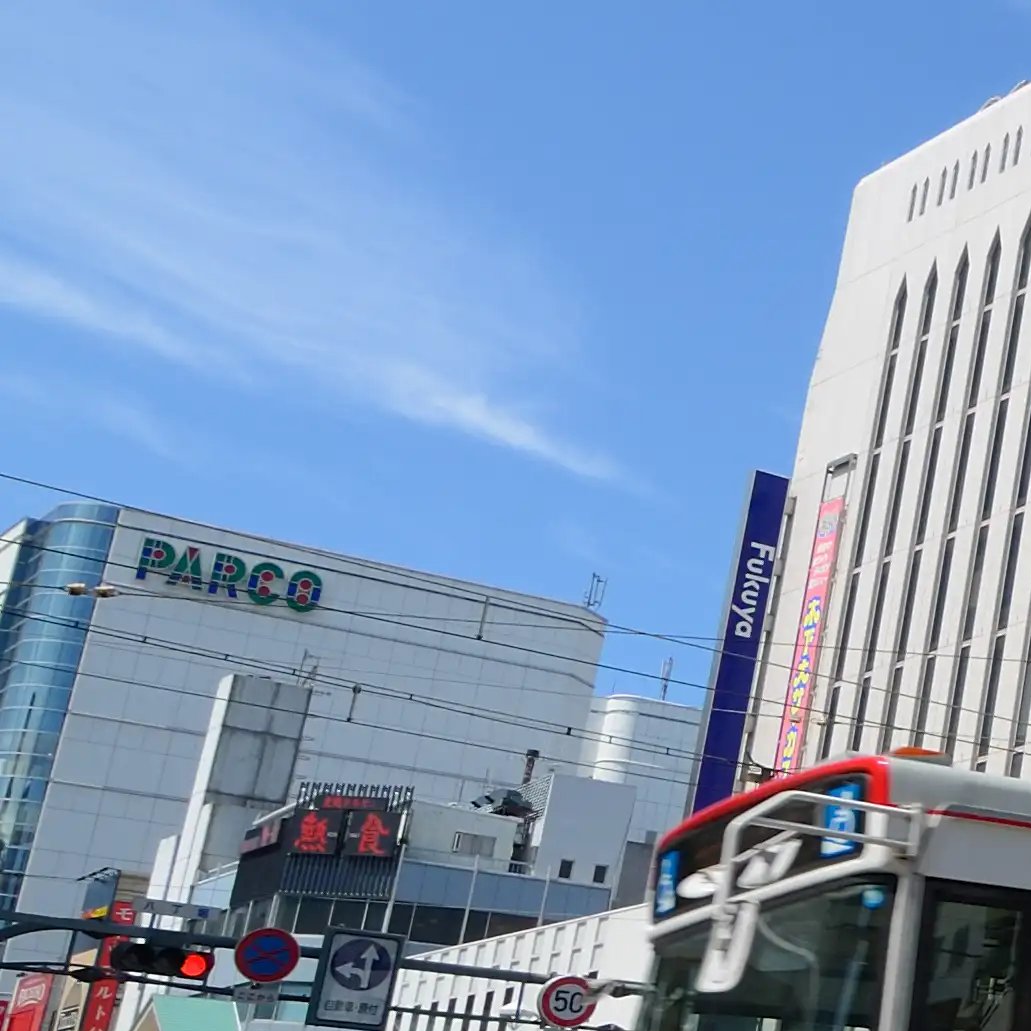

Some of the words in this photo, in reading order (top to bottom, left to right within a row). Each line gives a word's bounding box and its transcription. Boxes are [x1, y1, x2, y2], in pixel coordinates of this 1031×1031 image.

[135, 537, 322, 613] PARCO
[731, 541, 776, 639] Fukuya
[553, 990, 583, 1013] 50
